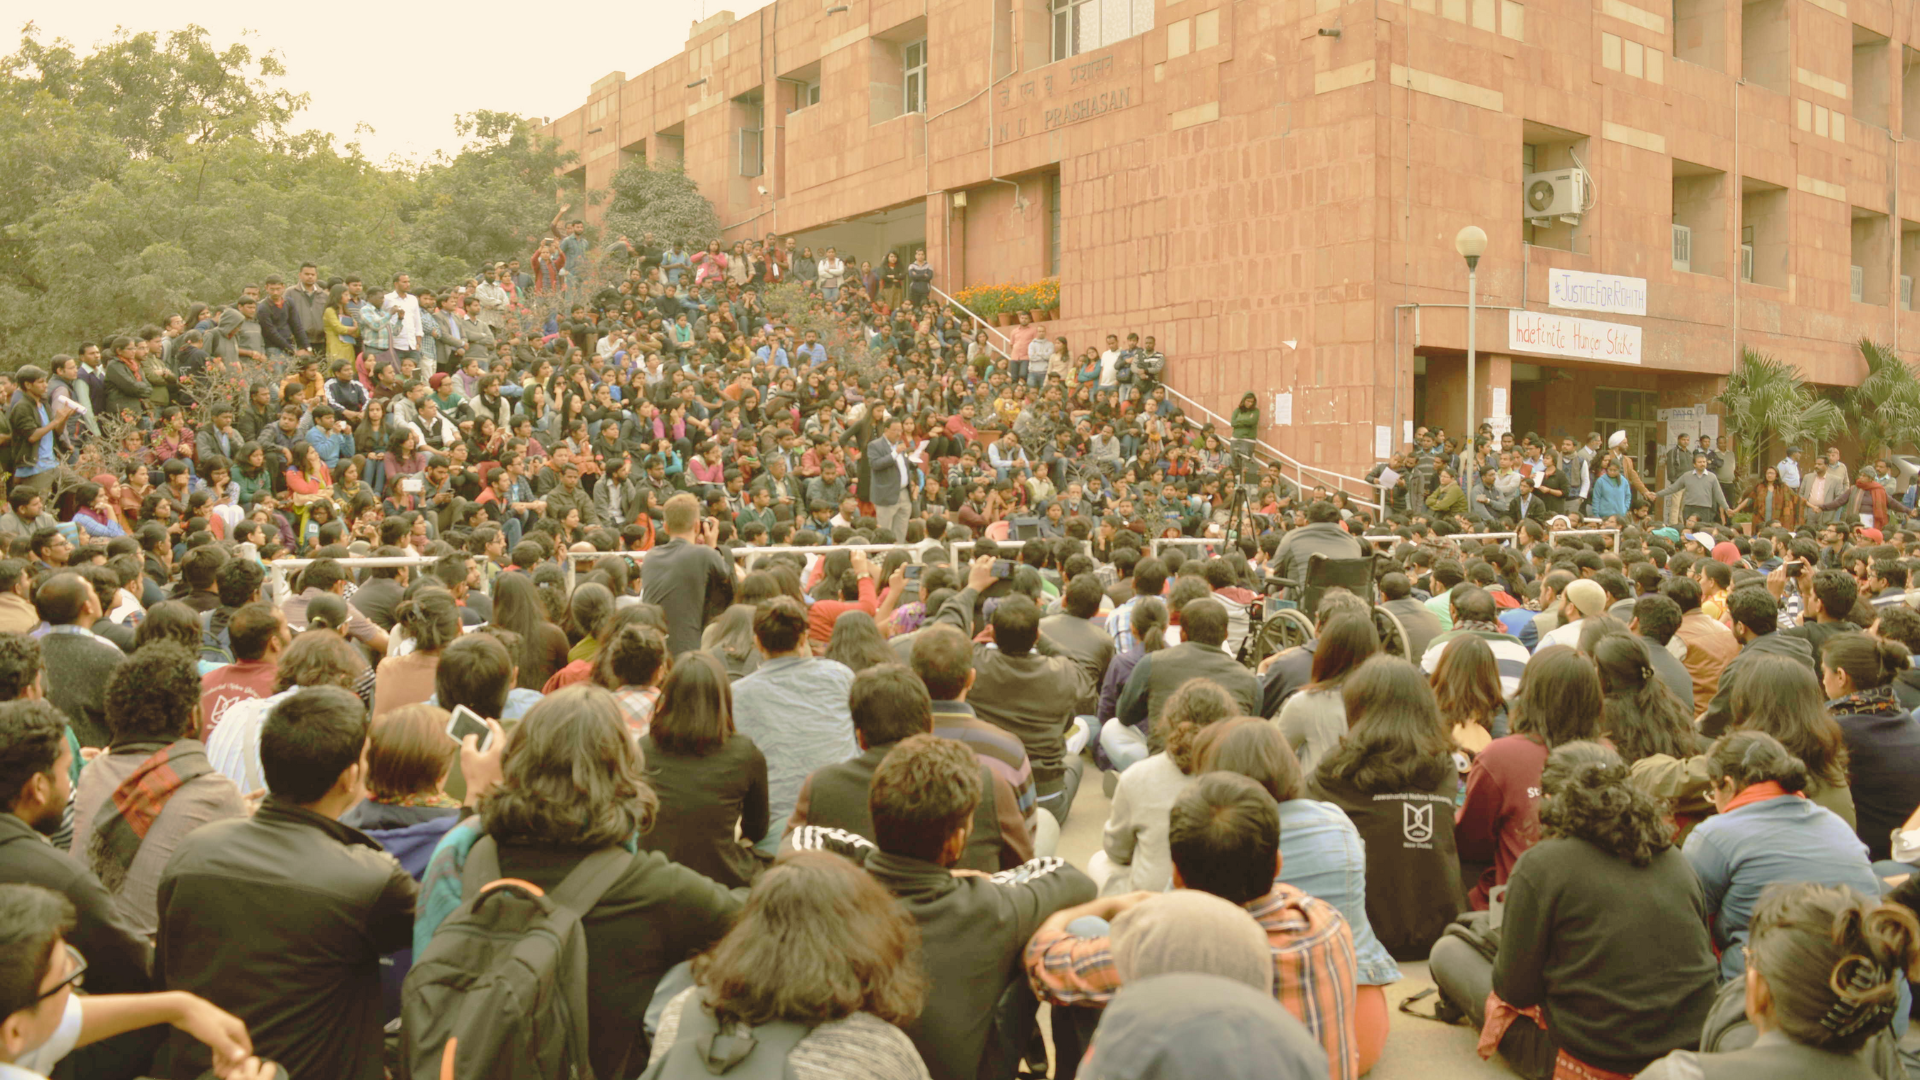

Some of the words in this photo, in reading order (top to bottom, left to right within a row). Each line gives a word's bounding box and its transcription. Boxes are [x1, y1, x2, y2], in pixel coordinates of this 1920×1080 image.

[1019, 80, 1034, 101] एन
[1070, 55, 1113, 85] प्रशासन
[999, 122, 1009, 143] N
[1018, 118, 1027, 137] U
[1044, 86, 1131, 130] PRASHASAN
[1516, 315, 1566, 349] Indefinite
